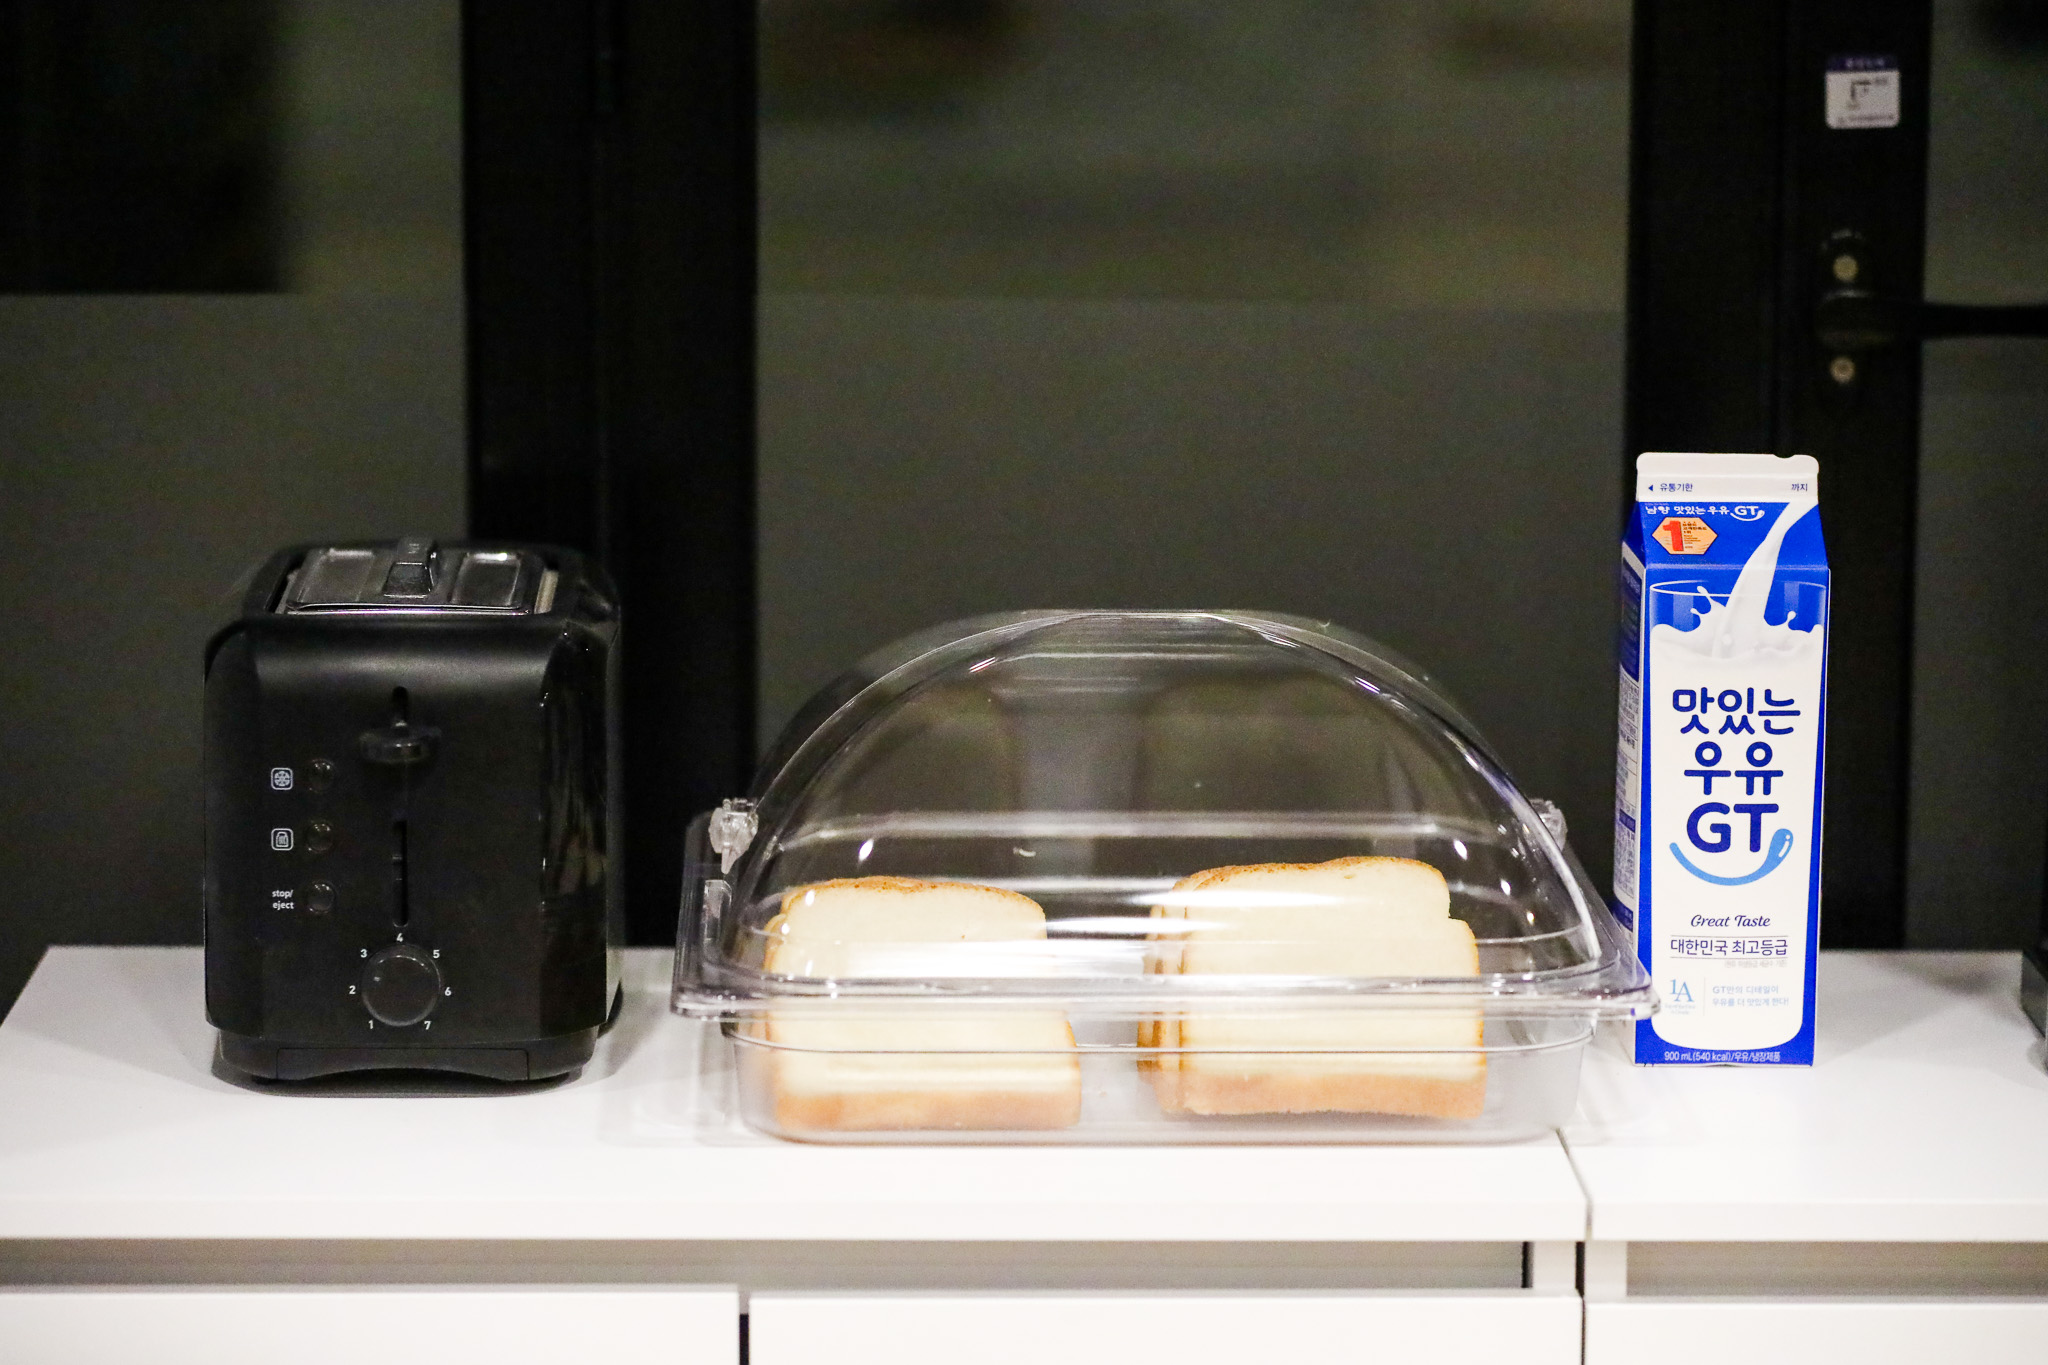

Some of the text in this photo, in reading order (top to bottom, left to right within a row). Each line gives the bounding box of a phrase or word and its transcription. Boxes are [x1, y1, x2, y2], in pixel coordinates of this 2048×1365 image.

[1660, 483, 1693, 492] 유통기한
[1791, 483, 1808, 492] 까지
[1673, 506, 1706, 515] 맛있는
[1707, 506, 1729, 515] 우유
[1734, 506, 1759, 516] GT
[1672, 687, 1801, 735] 맛있는
[1684, 741, 1784, 796] 우유
[1686, 802, 1779, 853] GT
[272, 889, 294, 899] stop/
[272, 900, 295, 910] eject
[1690, 914, 1771, 927] Great Taste
[396, 933, 404, 943] 4
[1670, 939, 1788, 956] 대한민국 최고등급
[360, 949, 368, 958] 3
[433, 949, 440, 959] 5
[348, 985, 356, 995] 2
[444, 987, 452, 996] 6
[368, 1020, 374, 1029] 1
[424, 1020, 432, 1030] 7
[1664, 1051, 1680, 1061] 900
